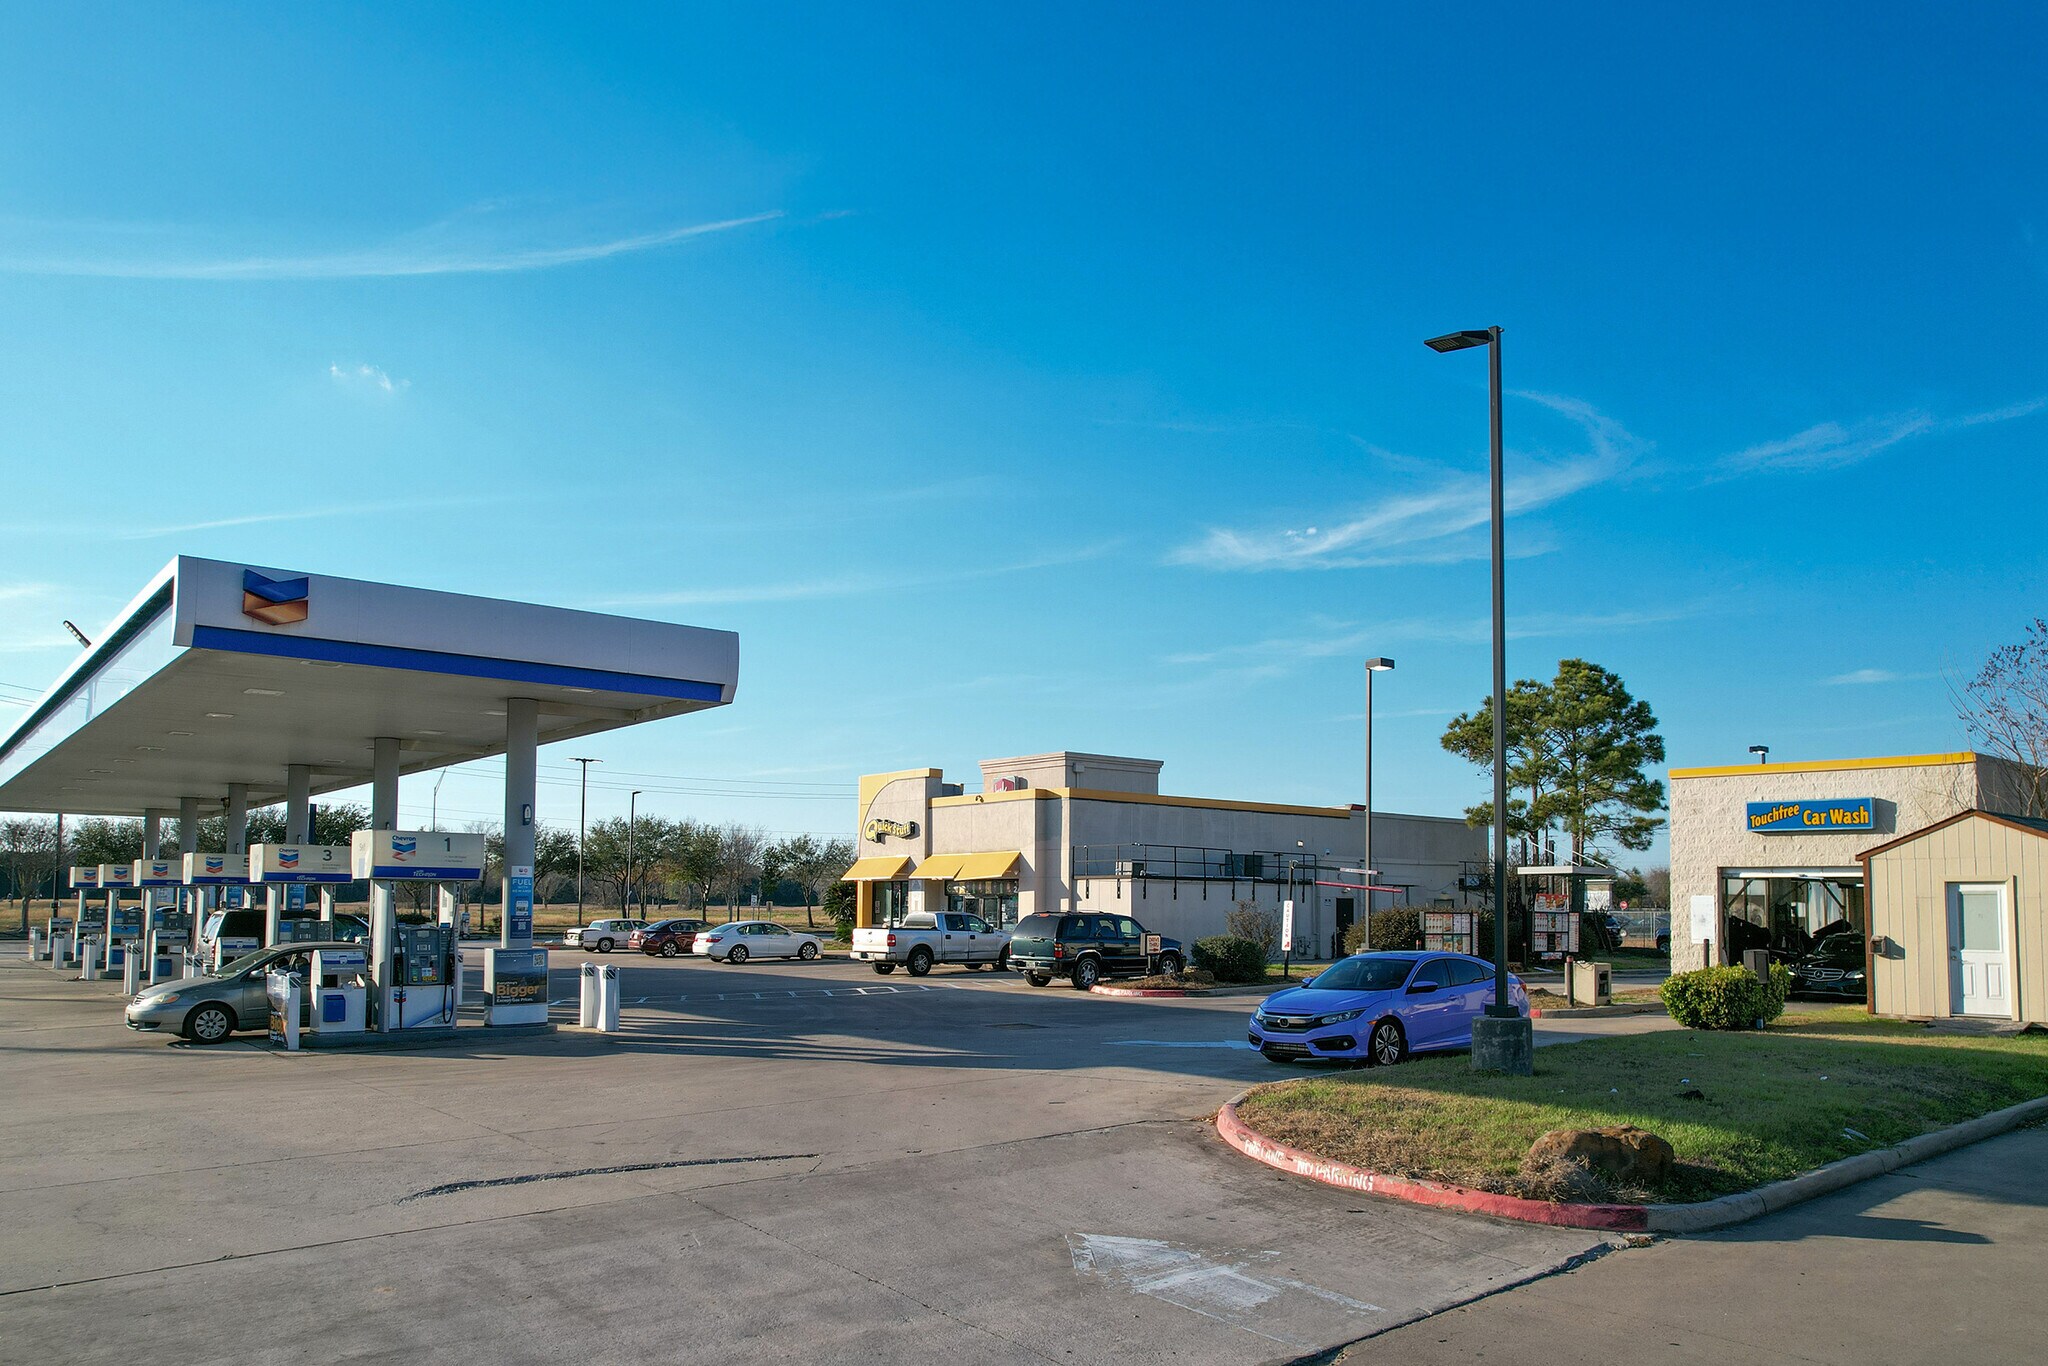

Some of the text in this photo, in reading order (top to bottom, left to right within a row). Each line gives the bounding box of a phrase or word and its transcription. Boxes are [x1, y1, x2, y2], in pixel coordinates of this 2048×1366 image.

[1749, 803, 1869, 828] Touchfree Car Wash
[392, 834, 417, 842] Chevron
[444, 837, 451, 852] 1
[322, 849, 333, 862] 3
[512, 878, 532, 886] FUEL
[496, 984, 540, 997] Bigger
[1296, 1159, 1374, 1192] NO PARKING
